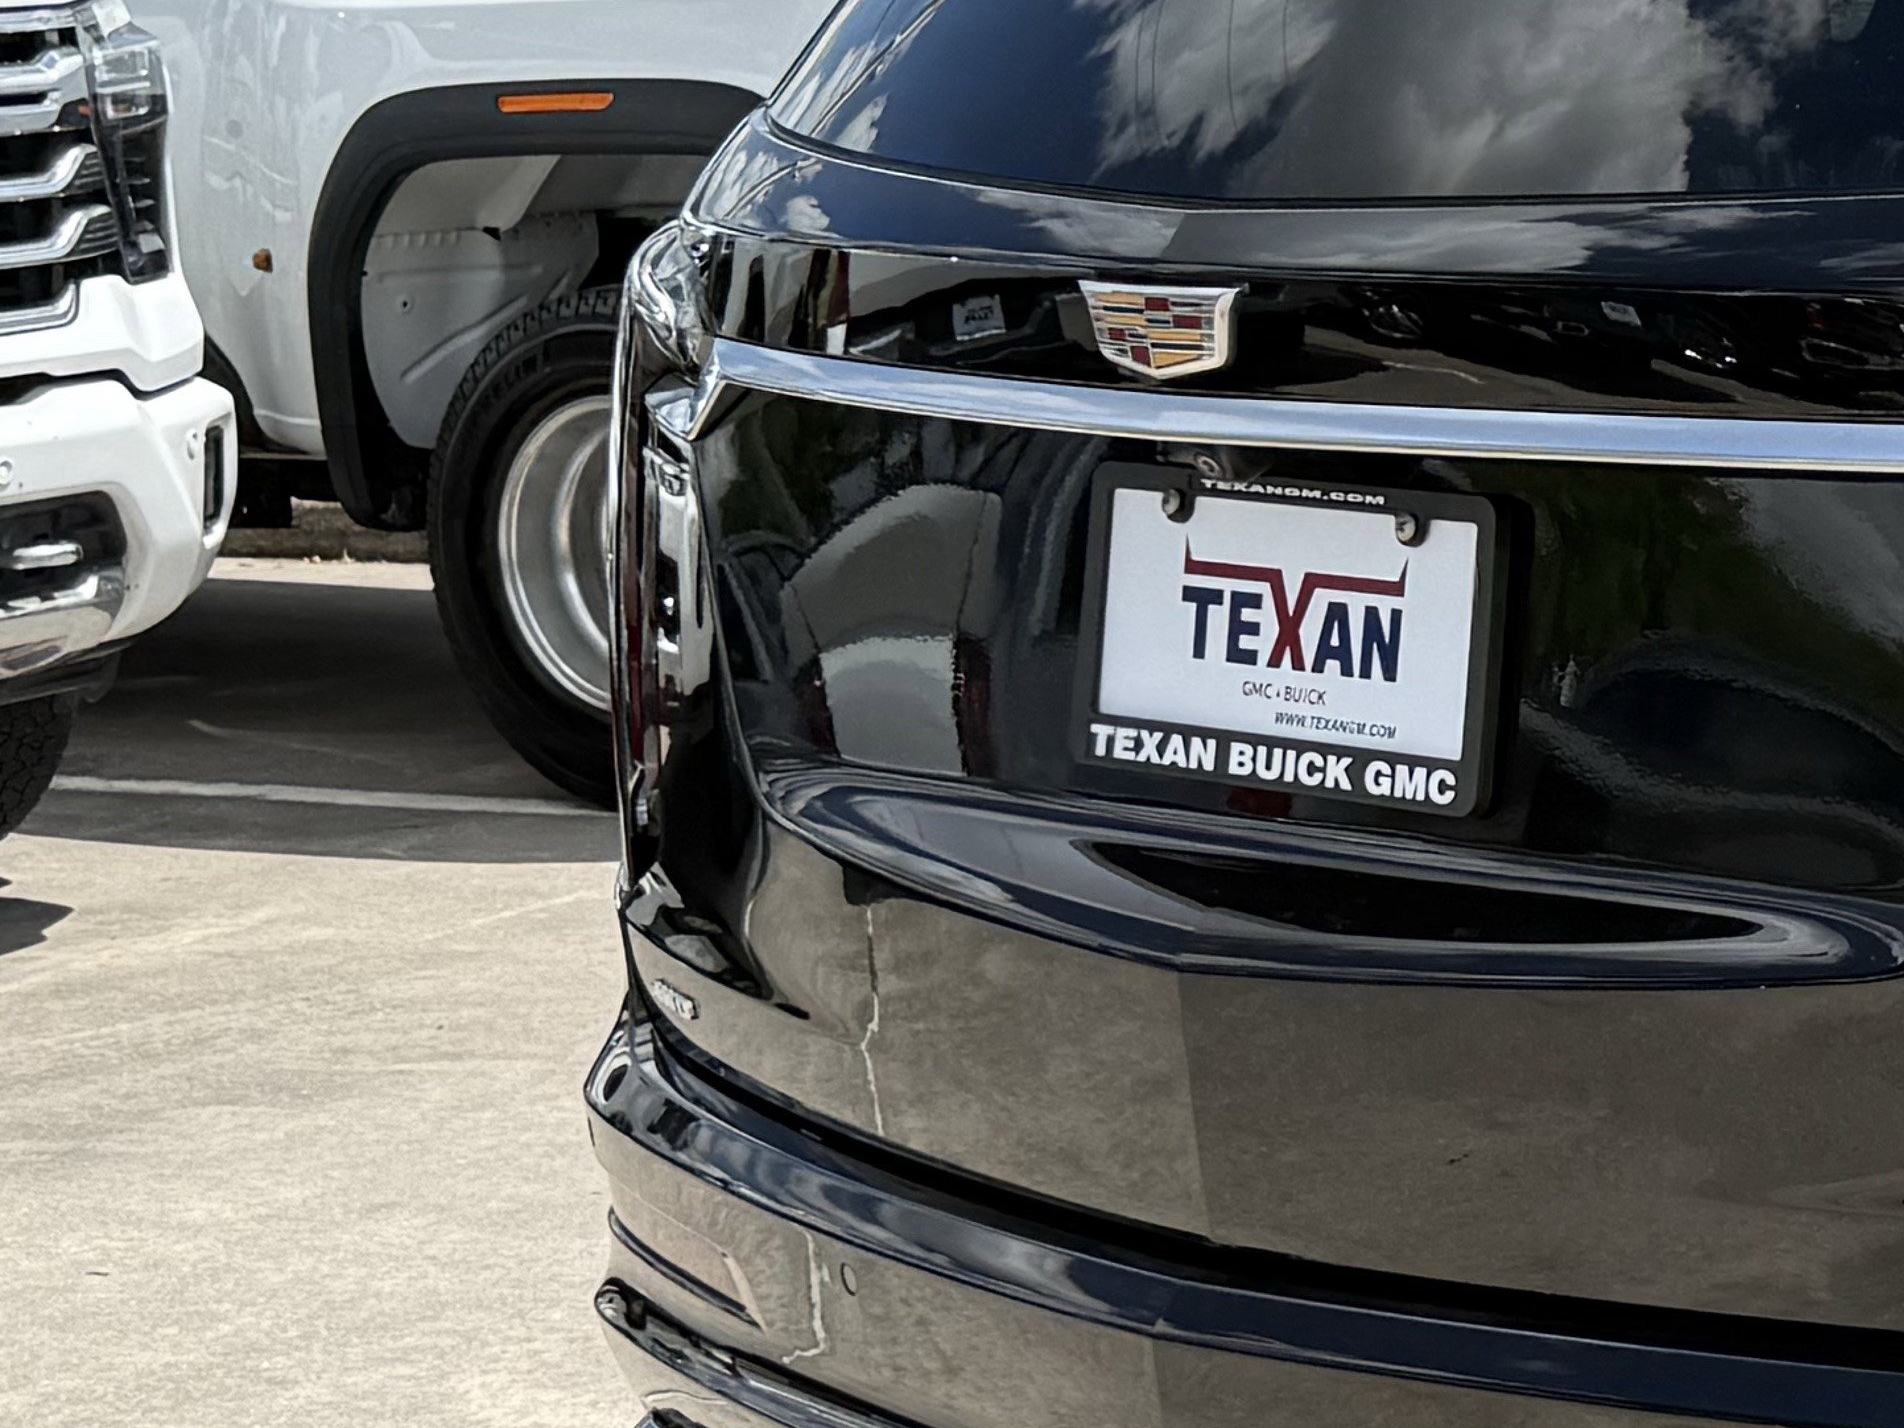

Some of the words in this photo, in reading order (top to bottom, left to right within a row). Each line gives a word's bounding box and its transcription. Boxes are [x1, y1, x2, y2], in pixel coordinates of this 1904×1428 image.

[1182, 534, 1409, 682] TEXAN
[1243, 681, 1272, 699] GMC
[1284, 685, 1326, 706] BUICK
[1090, 724, 1217, 771] TEXAN
[1228, 742, 1353, 791] BUICK
[1364, 760, 1457, 805] GMC
